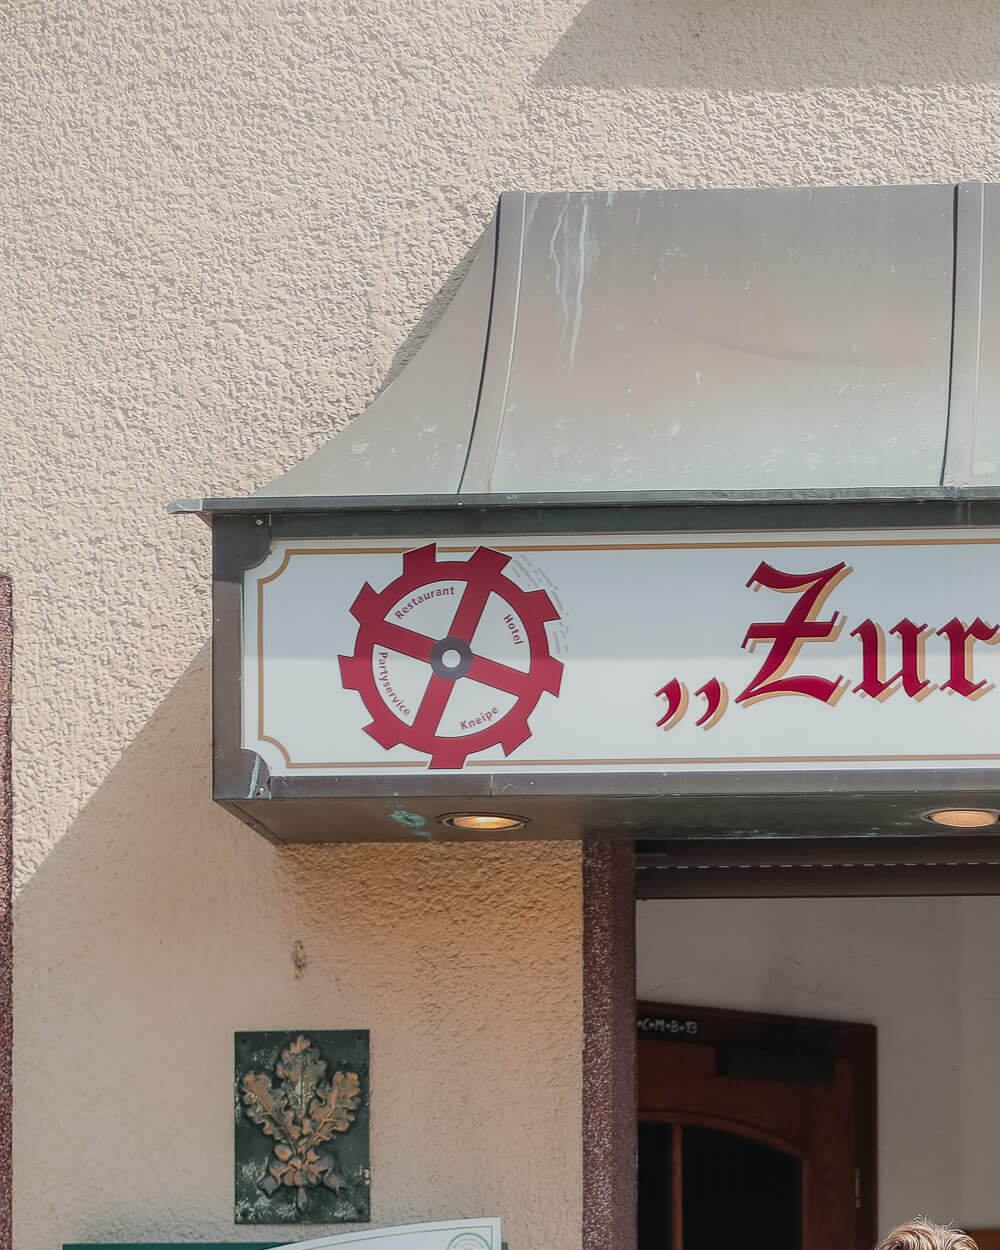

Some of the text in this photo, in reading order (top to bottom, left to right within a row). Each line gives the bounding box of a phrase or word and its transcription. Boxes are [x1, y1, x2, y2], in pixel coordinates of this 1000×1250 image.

[394, 586, 456, 620] Restaurant
[503, 613, 525, 645] Hotel
[378, 651, 411, 717] Partyservice
[460, 705, 500, 731] Kneipe
